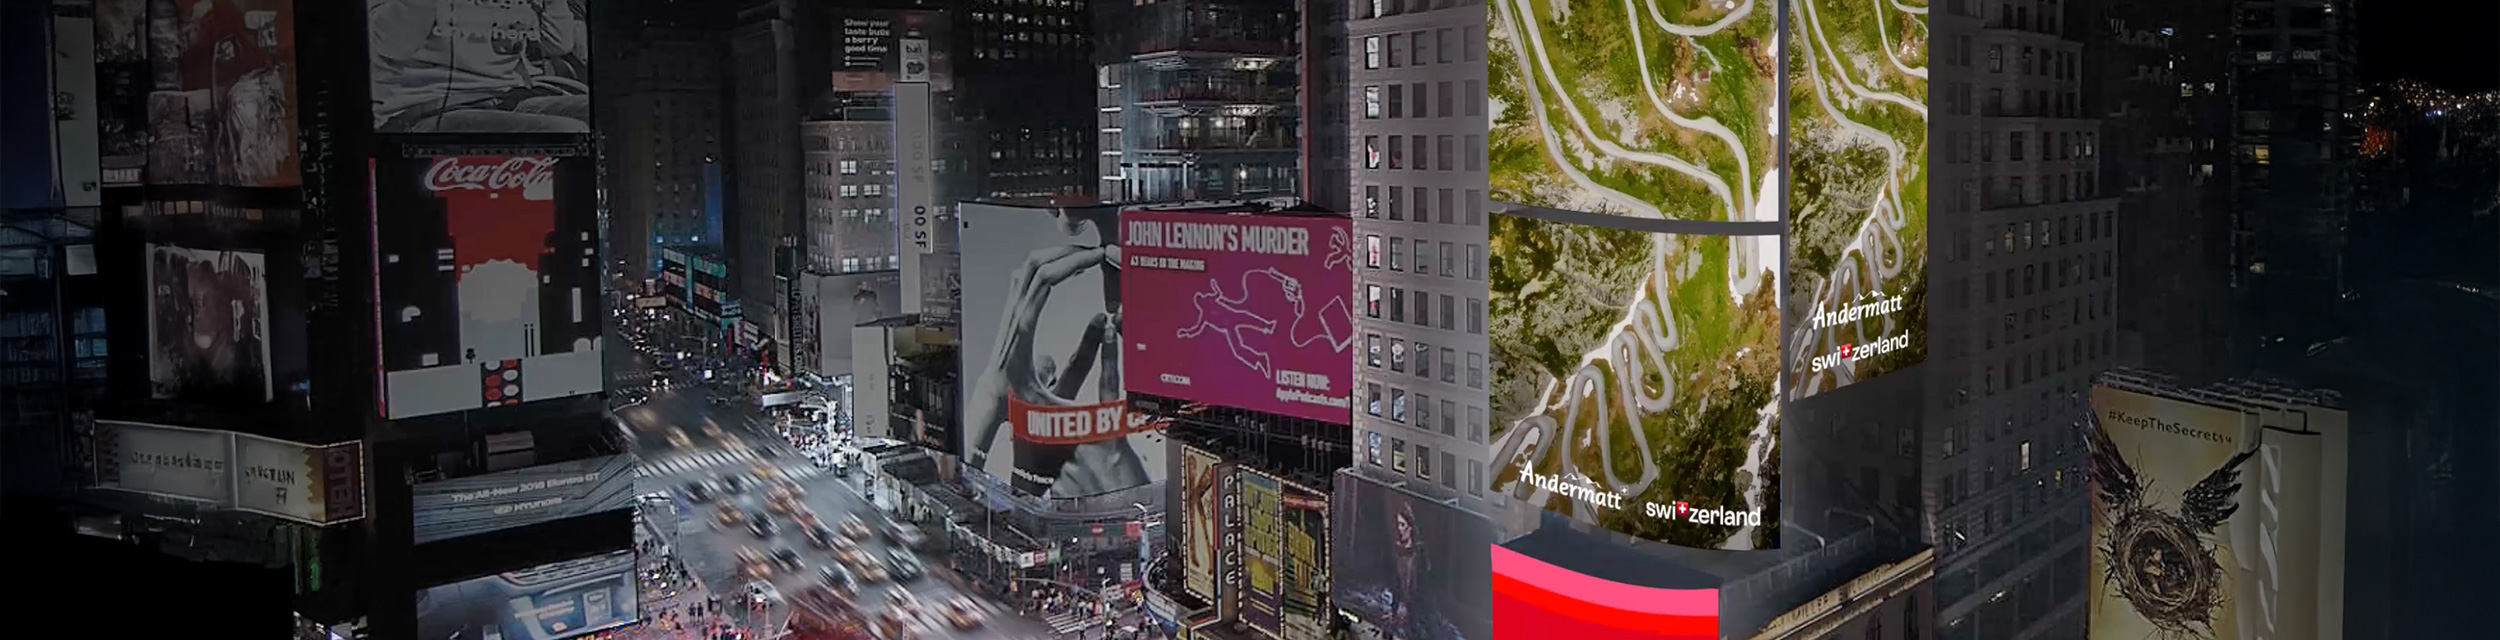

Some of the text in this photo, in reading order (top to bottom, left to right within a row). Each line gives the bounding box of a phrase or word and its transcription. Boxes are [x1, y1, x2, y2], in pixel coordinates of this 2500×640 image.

[844, 28, 890, 36] taste buds
[852, 36, 879, 45] berry
[844, 46, 866, 54] good
[424, 156, 560, 192] Coca-Cola
[915, 230, 927, 249] SF
[1125, 220, 1310, 256] JOHN LENNON'S MURDER
[1812, 291, 1904, 331] Andermatt
[1276, 369, 1306, 388] LISTEN
[1026, 408, 1093, 439] UNITED
[1096, 405, 1125, 435] BY
[1518, 459, 1624, 511] Andermatt
[1223, 475, 1237, 586] PALACE
